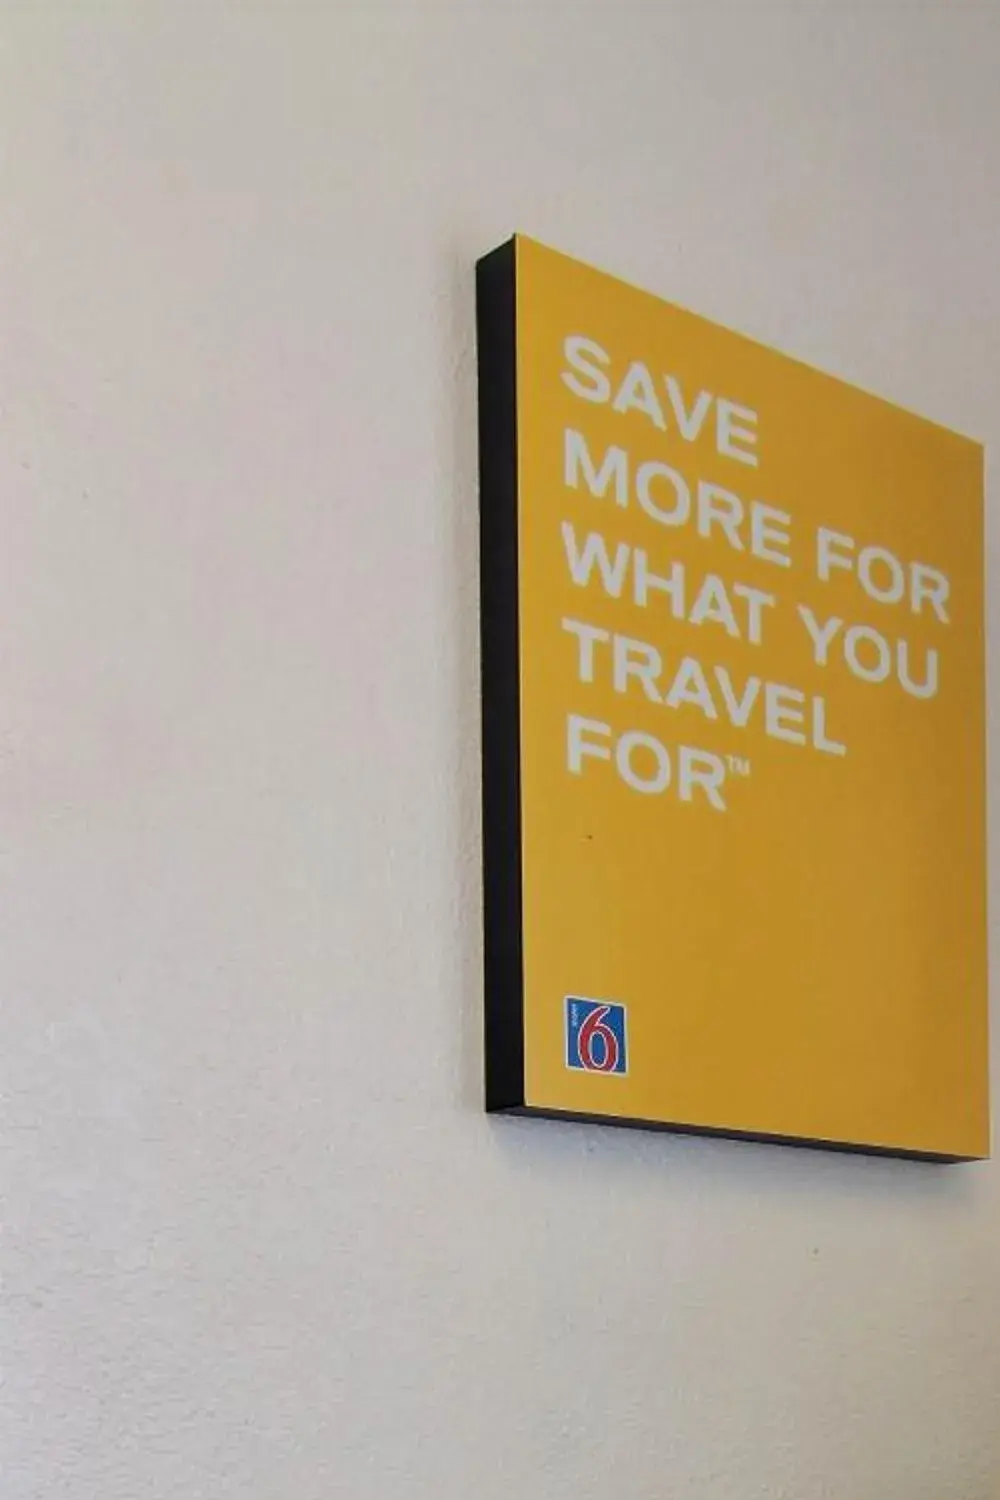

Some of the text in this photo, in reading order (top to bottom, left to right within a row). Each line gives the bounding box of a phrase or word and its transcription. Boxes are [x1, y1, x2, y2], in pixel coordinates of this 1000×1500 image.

[560, 333, 758, 467] SAVE
[563, 427, 950, 622] MORE FOR
[560, 520, 939, 698] WHAT YOU
[561, 616, 847, 755] TRAVEL
[577, 1005, 619, 1073] 6
